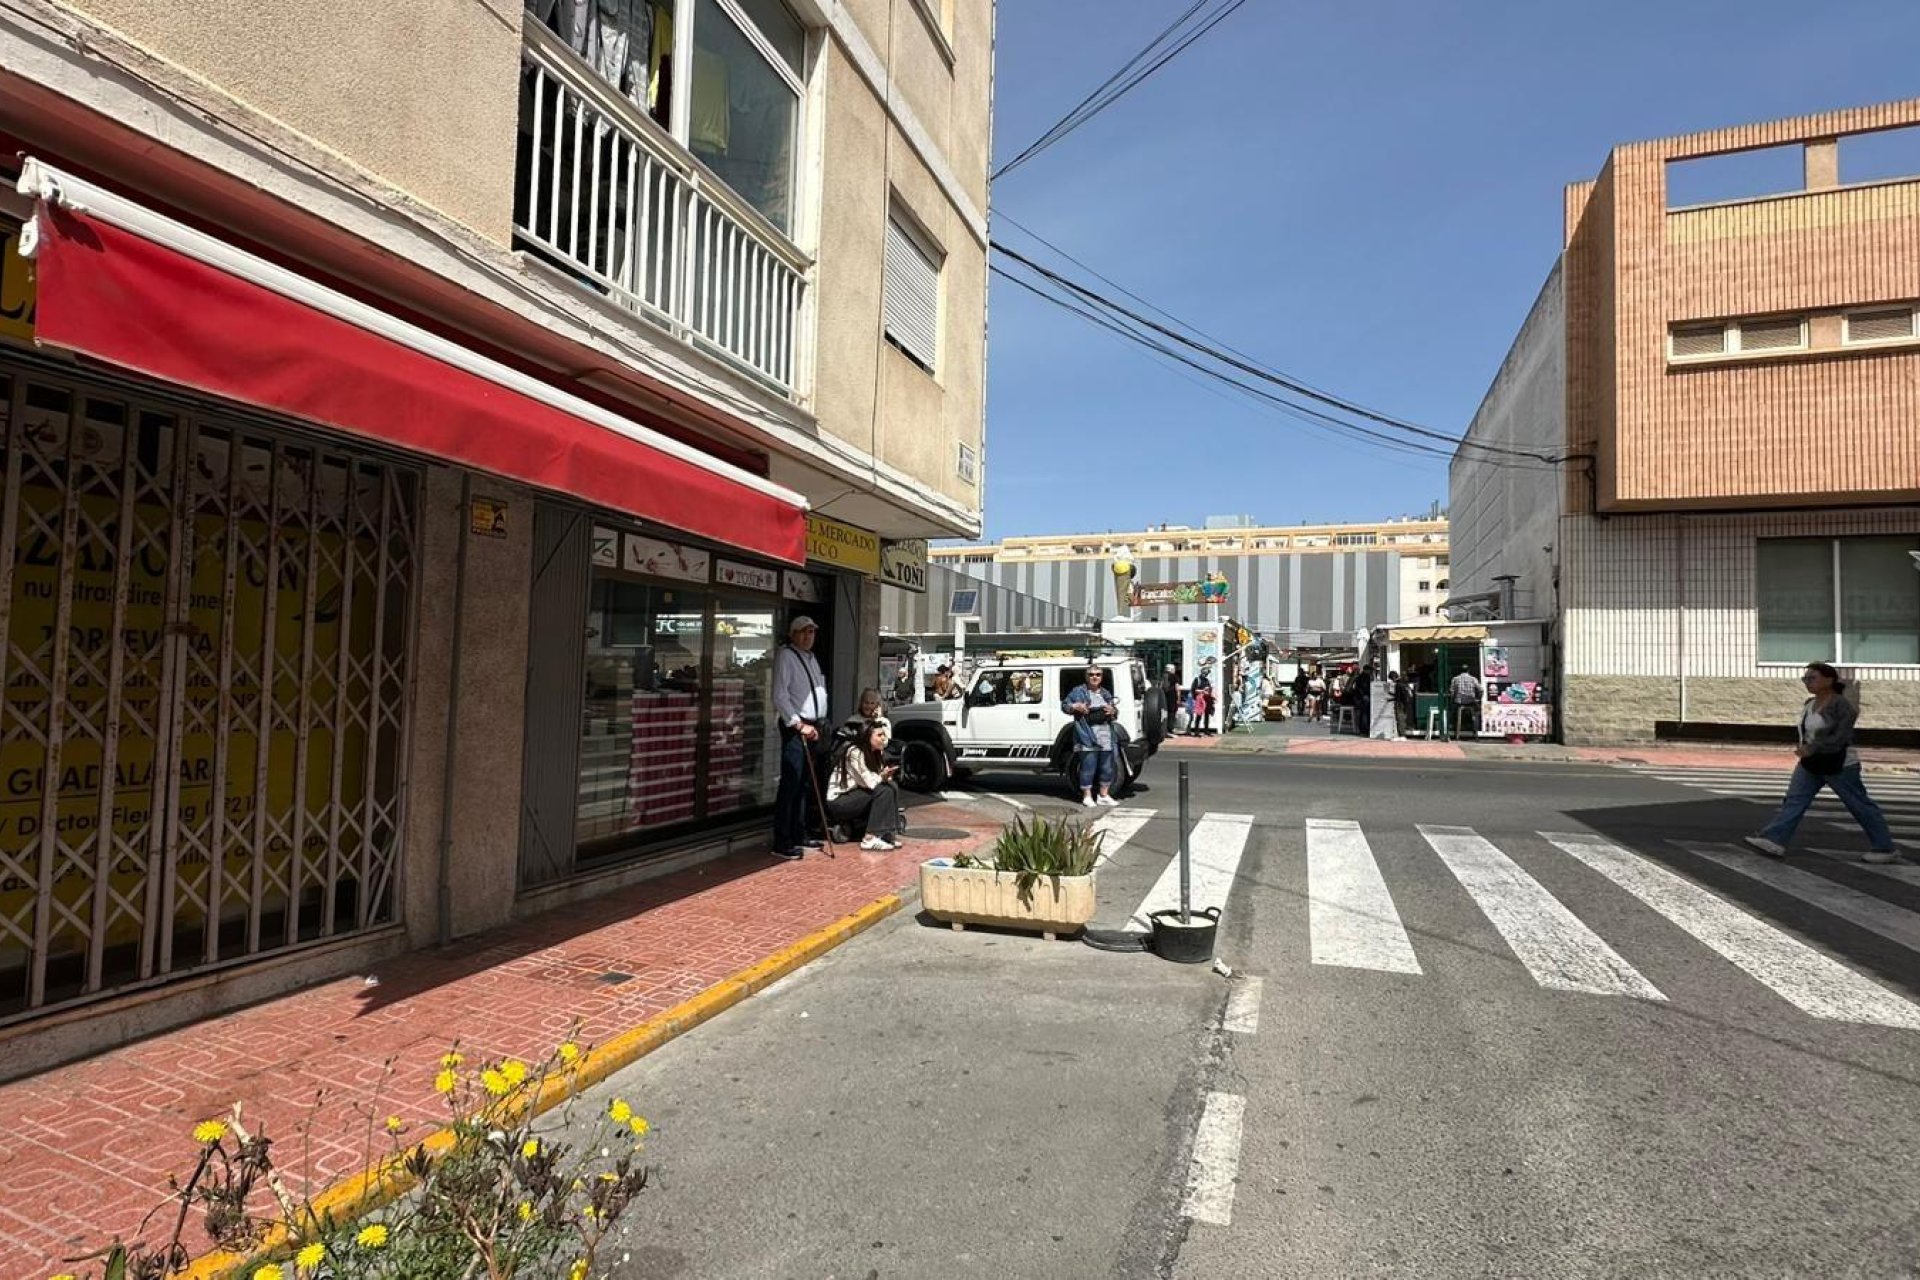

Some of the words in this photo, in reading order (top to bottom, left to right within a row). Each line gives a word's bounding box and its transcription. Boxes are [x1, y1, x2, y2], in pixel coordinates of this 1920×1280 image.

[805, 536, 838, 560] LICO
[820, 523, 876, 553] MERCADO
[896, 561, 924, 587] TOÑI
